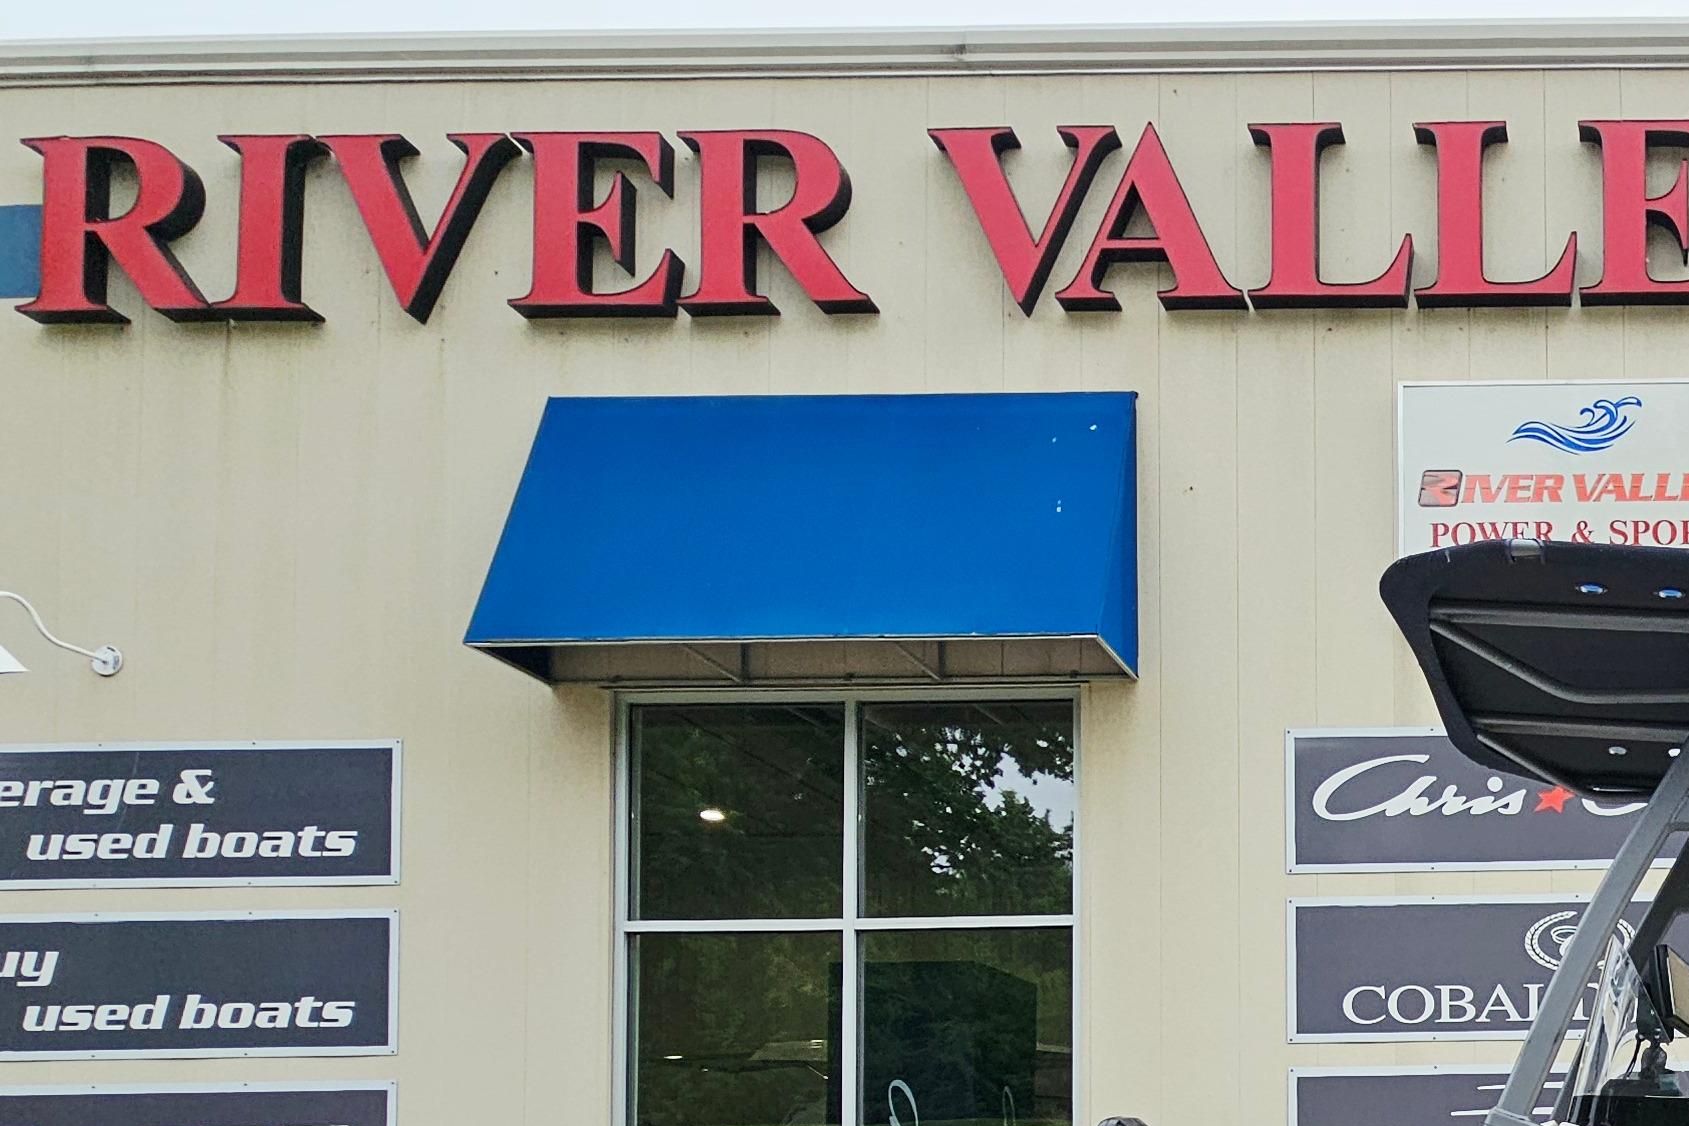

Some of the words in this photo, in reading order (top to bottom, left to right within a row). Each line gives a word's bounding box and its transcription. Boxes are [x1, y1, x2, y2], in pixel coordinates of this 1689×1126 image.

[14, 130, 880, 324] RIVER
[1418, 469, 1565, 508] RIVER
[1430, 521, 1553, 548] POWER
[1571, 520, 1594, 545] &
[172, 769, 216, 805] &
[1312, 754, 1527, 821] Chris
[26, 824, 174, 861] used
[182, 824, 359, 860] boats
[22, 995, 171, 1033] used
[179, 995, 356, 1030] boats
